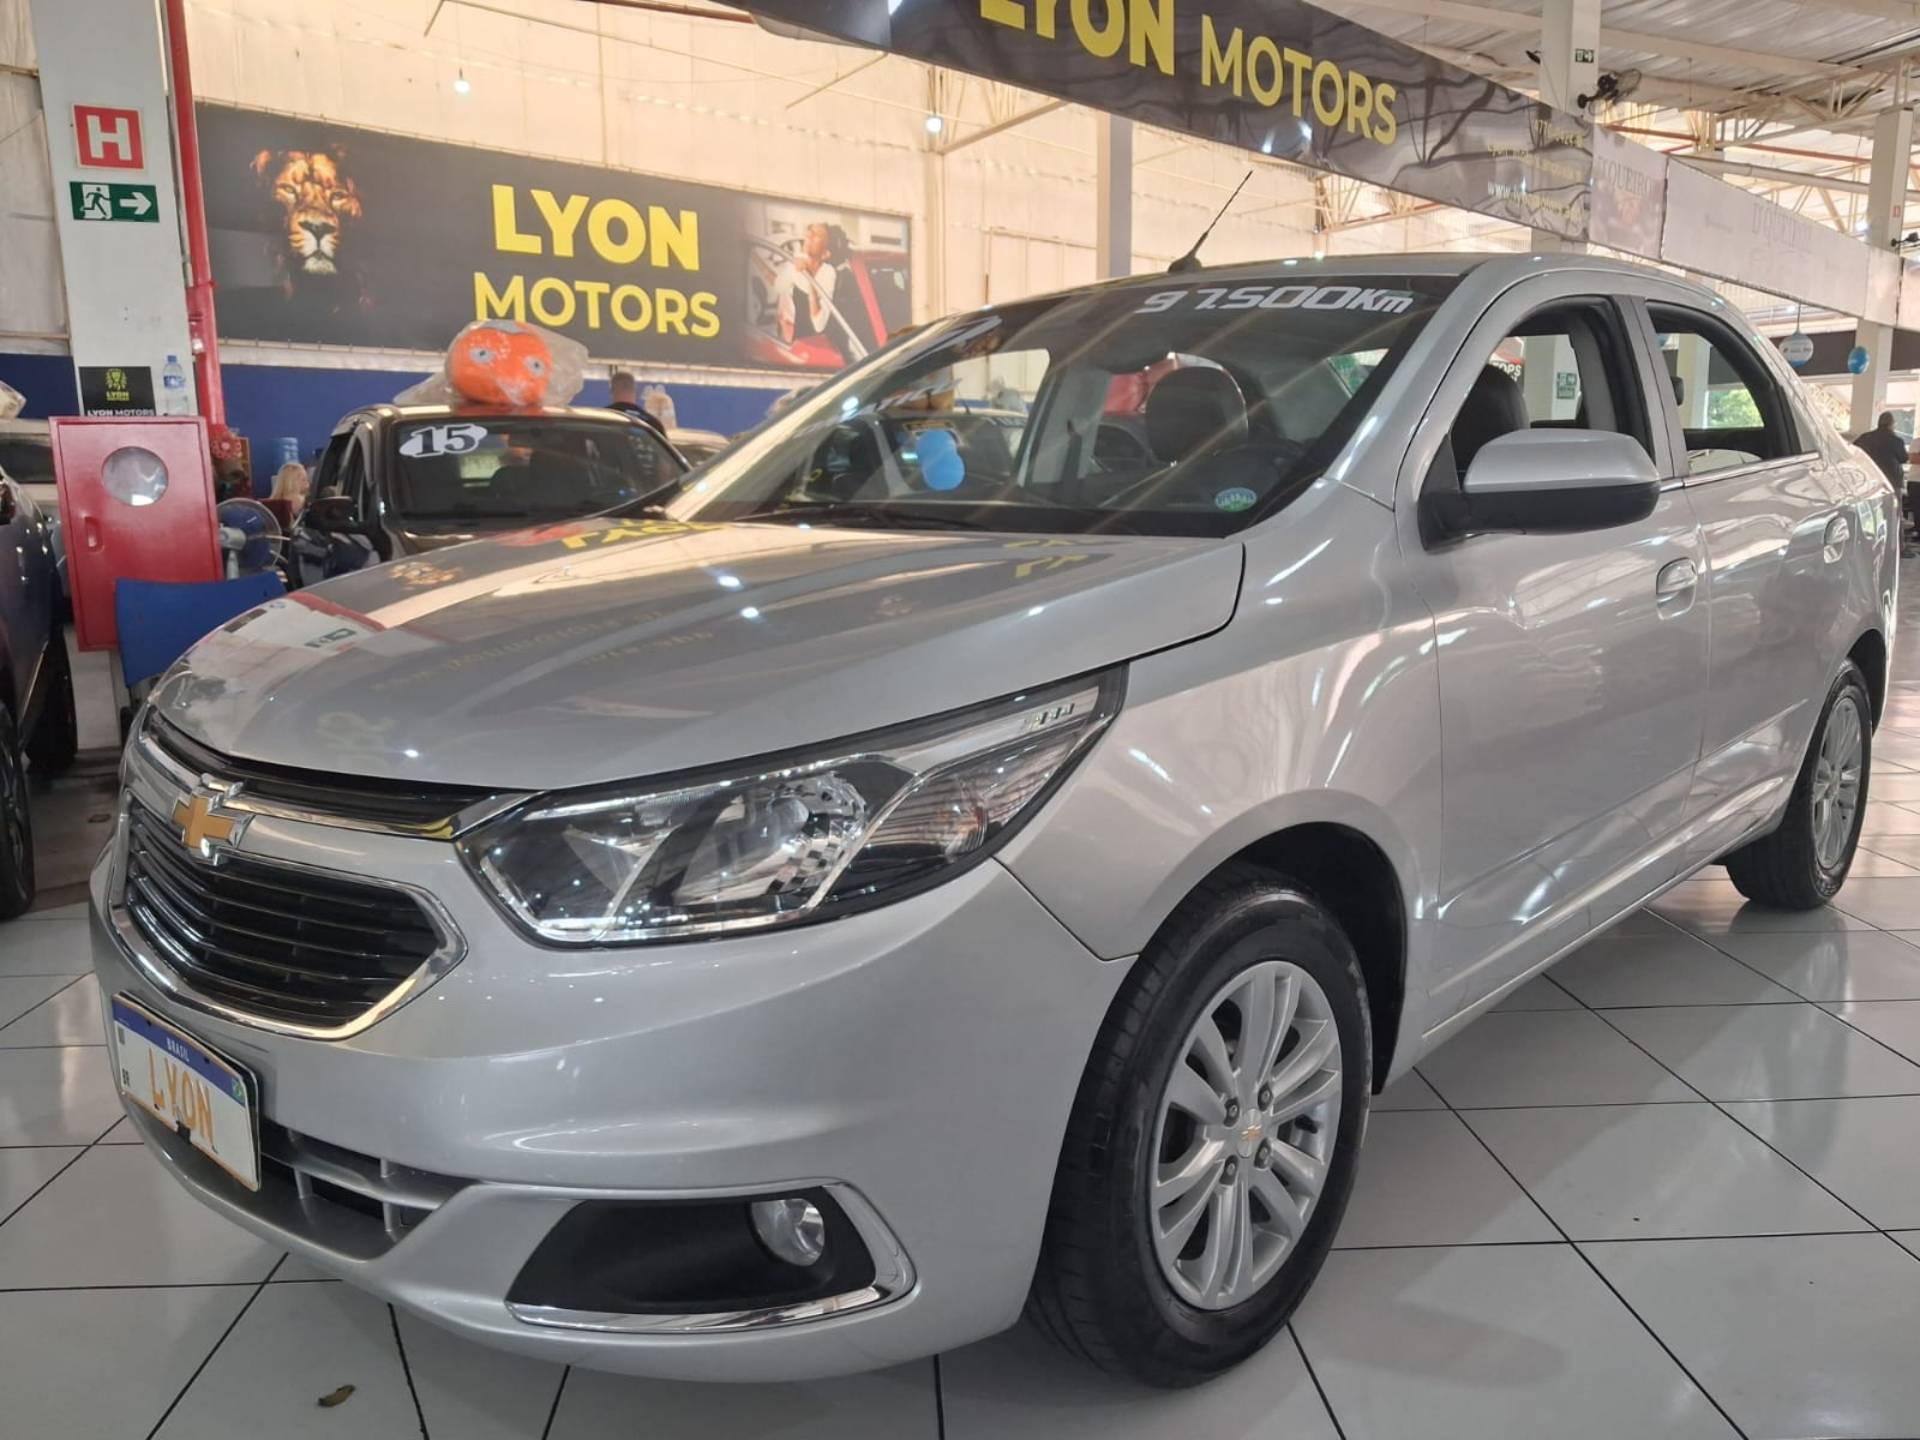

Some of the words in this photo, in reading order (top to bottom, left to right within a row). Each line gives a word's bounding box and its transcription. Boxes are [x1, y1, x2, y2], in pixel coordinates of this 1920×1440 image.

[980, 0, 1175, 76] ON
[1201, 15, 1398, 145] MOTORS
[87, 115, 132, 160] H
[492, 184, 700, 271] LYON
[474, 272, 721, 338] MOTORS
[415, 425, 476, 455] 15
[166, 1037, 190, 1062] BRASIL
[149, 1048, 215, 1146] LYON
